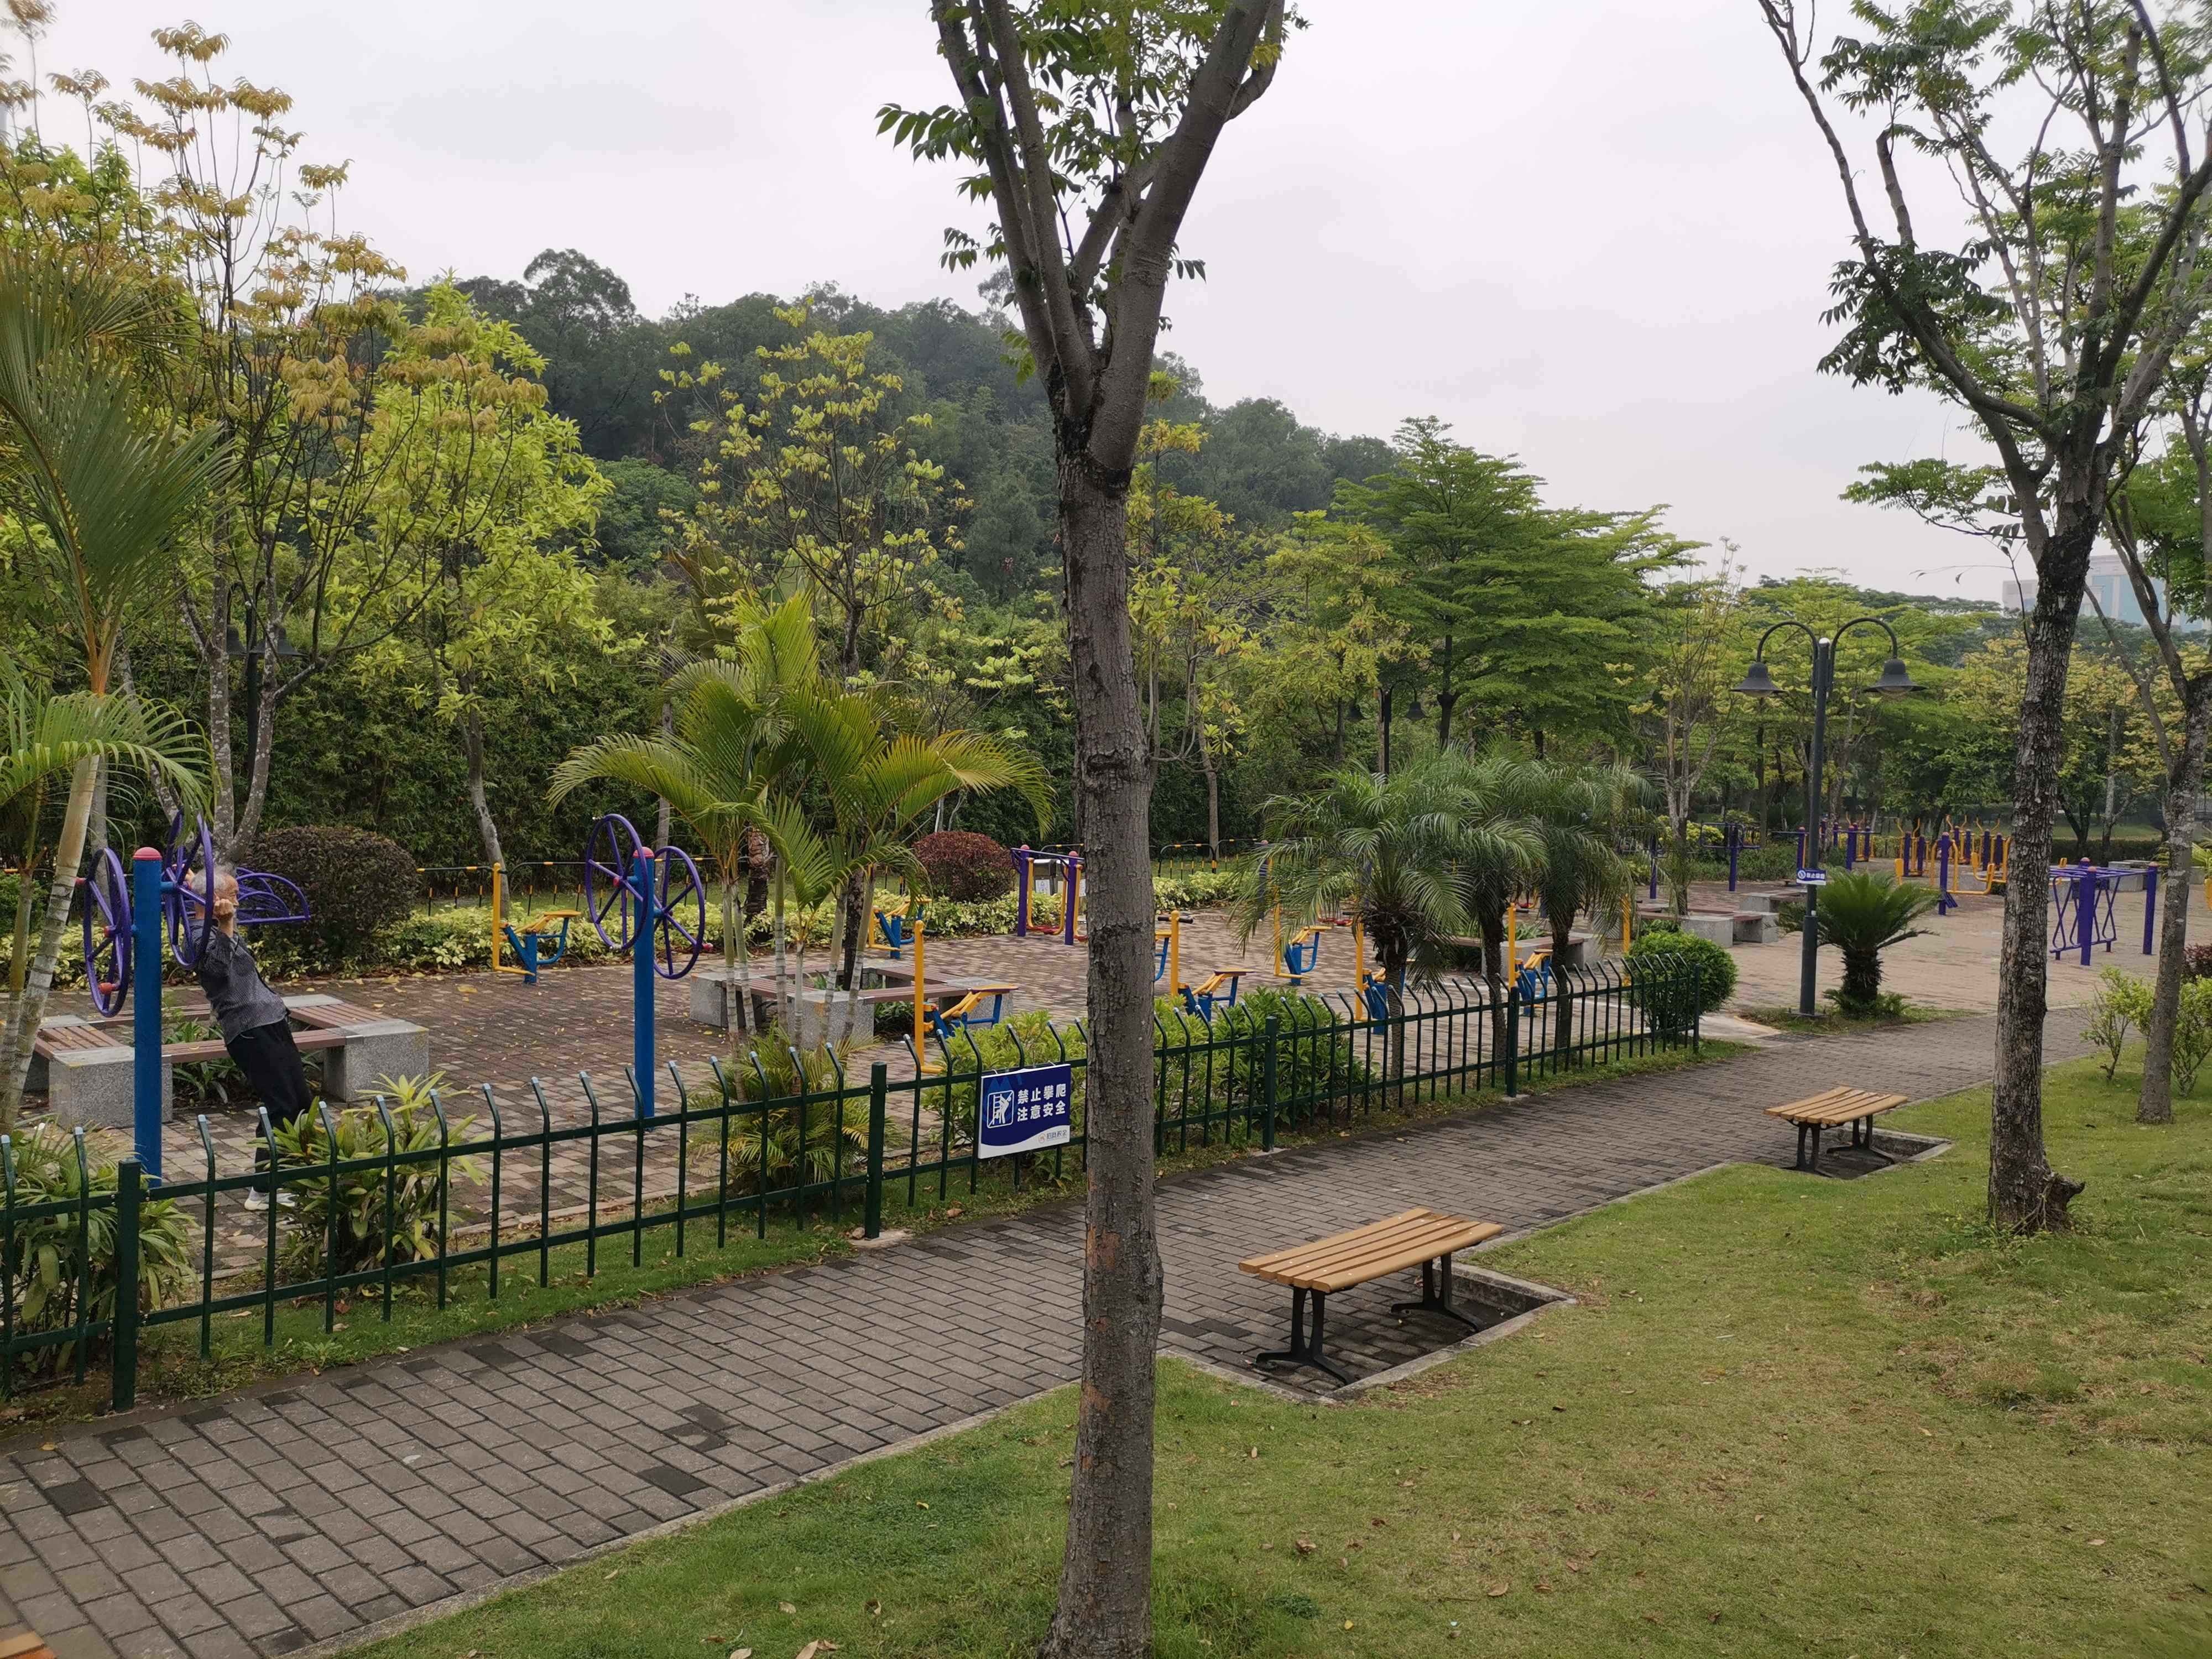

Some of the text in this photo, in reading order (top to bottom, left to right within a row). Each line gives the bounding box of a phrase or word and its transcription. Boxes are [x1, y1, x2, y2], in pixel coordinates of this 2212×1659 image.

[1018, 1083, 1066, 1104] 禁止攀爬
[1017, 1100, 1066, 1122] 注意安全
